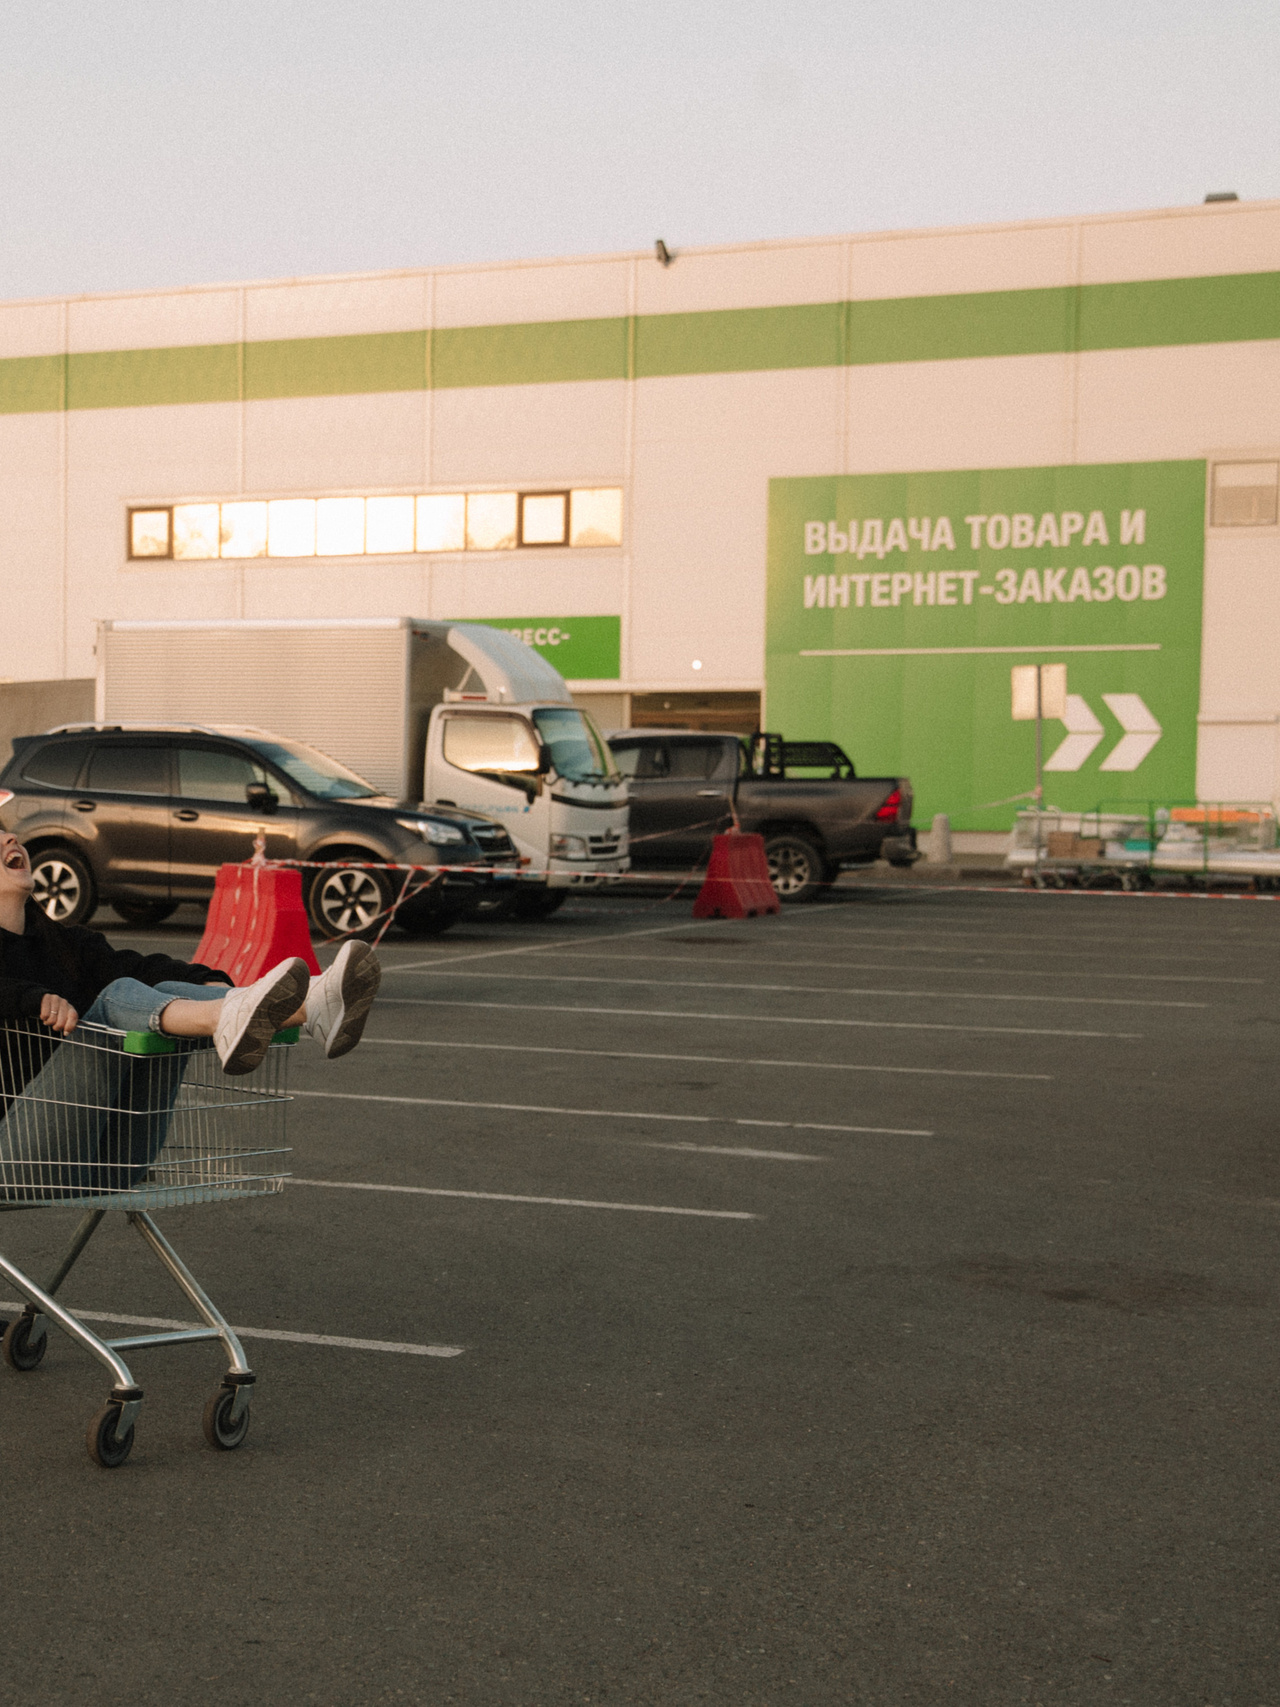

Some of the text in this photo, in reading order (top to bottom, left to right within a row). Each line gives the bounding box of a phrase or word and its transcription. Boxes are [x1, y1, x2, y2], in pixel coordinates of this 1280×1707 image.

[803, 508, 1147, 560] ВЫДАЧА ТОВАРА И
[803, 564, 1168, 609] ИНТЕРНЕТ-ЗАКАЗОВ
[503, 628, 570, 646] ЕСС-
